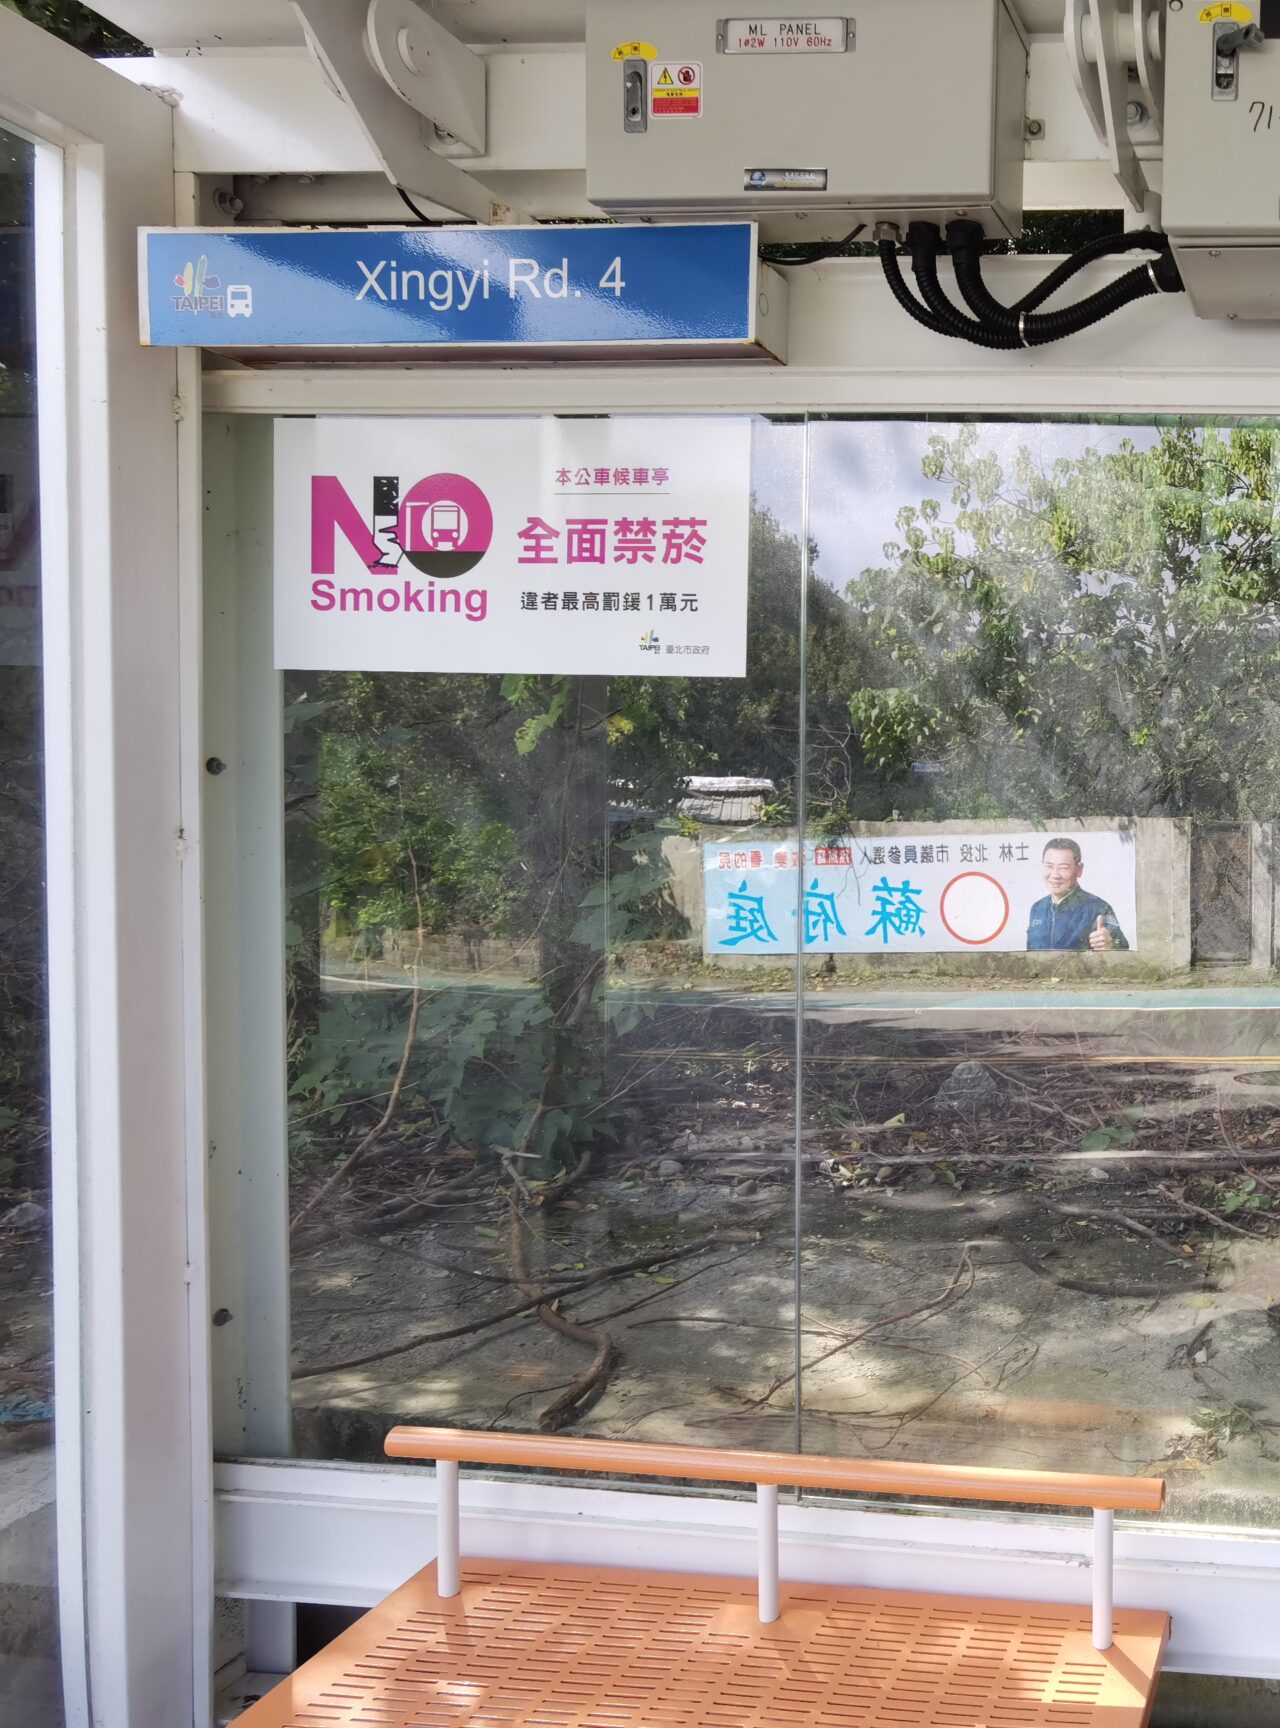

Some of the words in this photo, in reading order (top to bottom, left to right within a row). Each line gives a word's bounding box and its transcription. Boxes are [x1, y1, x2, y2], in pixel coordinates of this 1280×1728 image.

[748, 24, 768, 37] ML
[779, 23, 821, 36] PANEL
[773, 38, 799, 48] 110V
[806, 37, 832, 47] 60Hz
[355, 259, 490, 311] Xingyi
[508, 258, 582, 300] Rd.
[599, 256, 626, 297] 4
[171, 296, 224, 311] TAIPEI
[555, 467, 670, 487] 本公車候車亭
[311, 472, 494, 578] NO
[516, 516, 708, 565] 全面禁菸
[310, 579, 488, 622] Smoking
[665, 644, 710, 655] 臺北市政府
